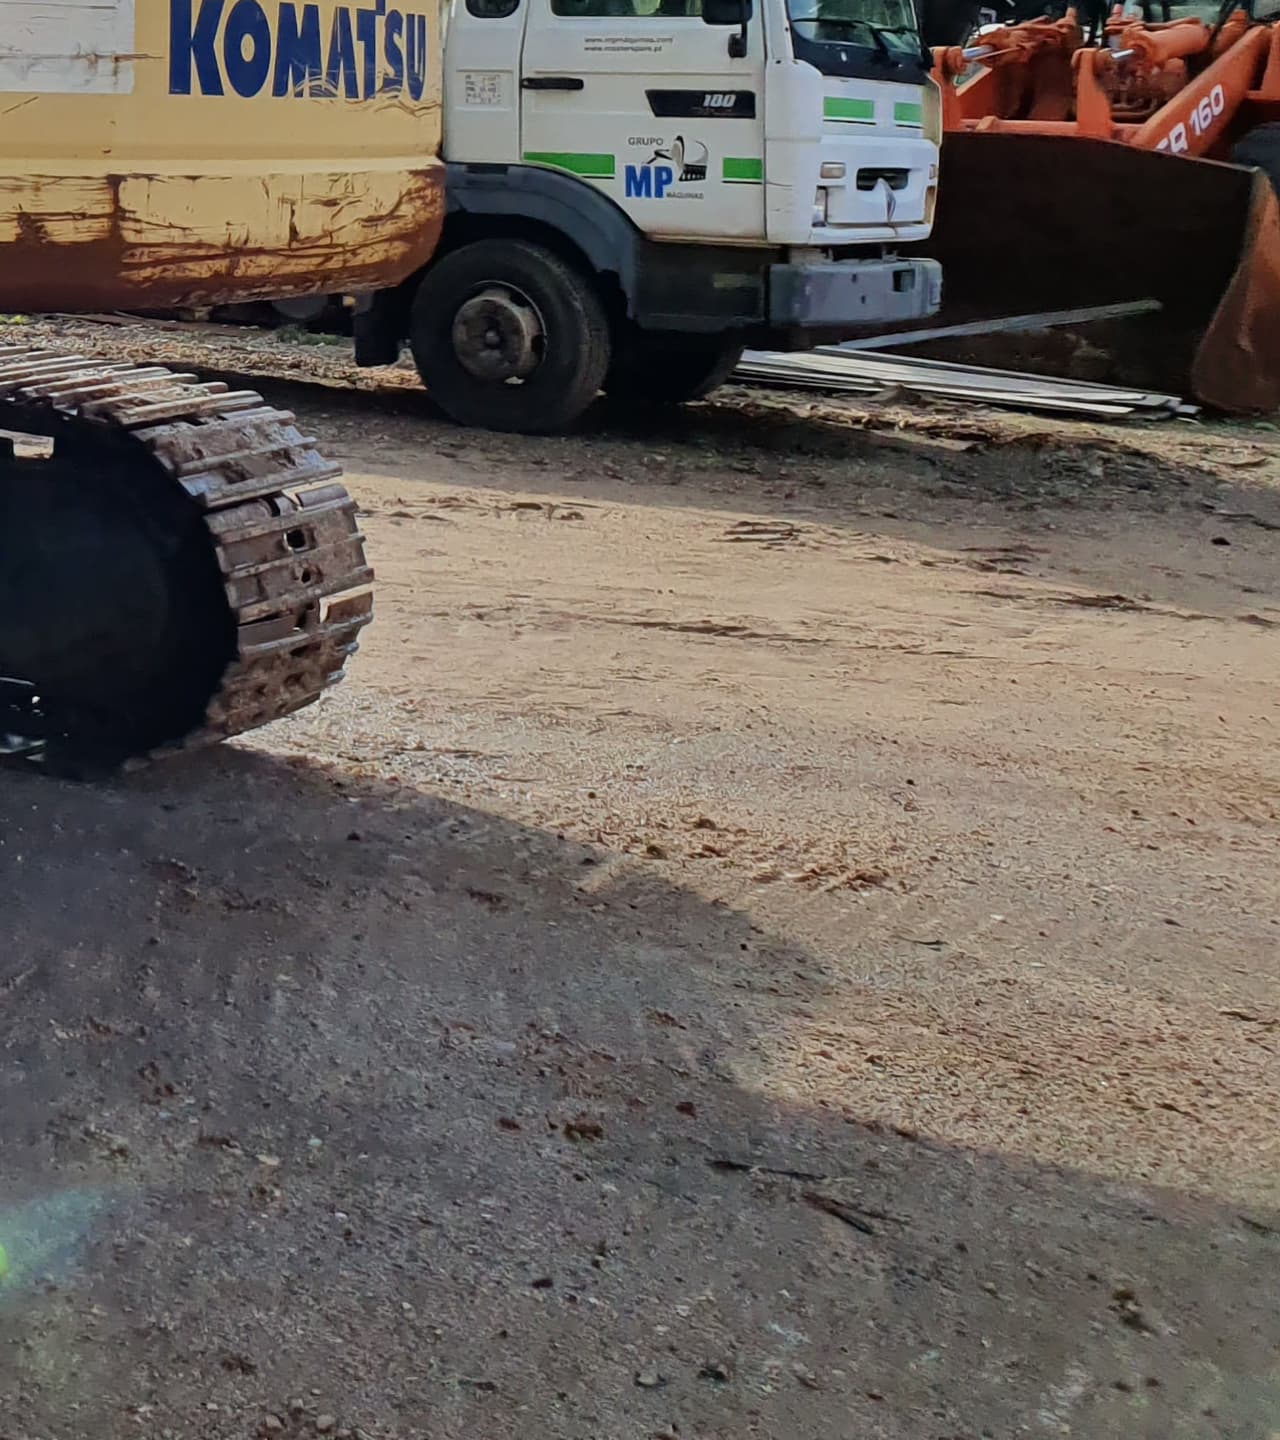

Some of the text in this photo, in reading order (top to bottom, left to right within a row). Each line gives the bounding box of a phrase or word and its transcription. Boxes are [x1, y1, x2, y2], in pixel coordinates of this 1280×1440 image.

[1190, 84, 1224, 136] 160
[627, 136, 664, 146] GRUPO
[624, 164, 673, 199] MP
